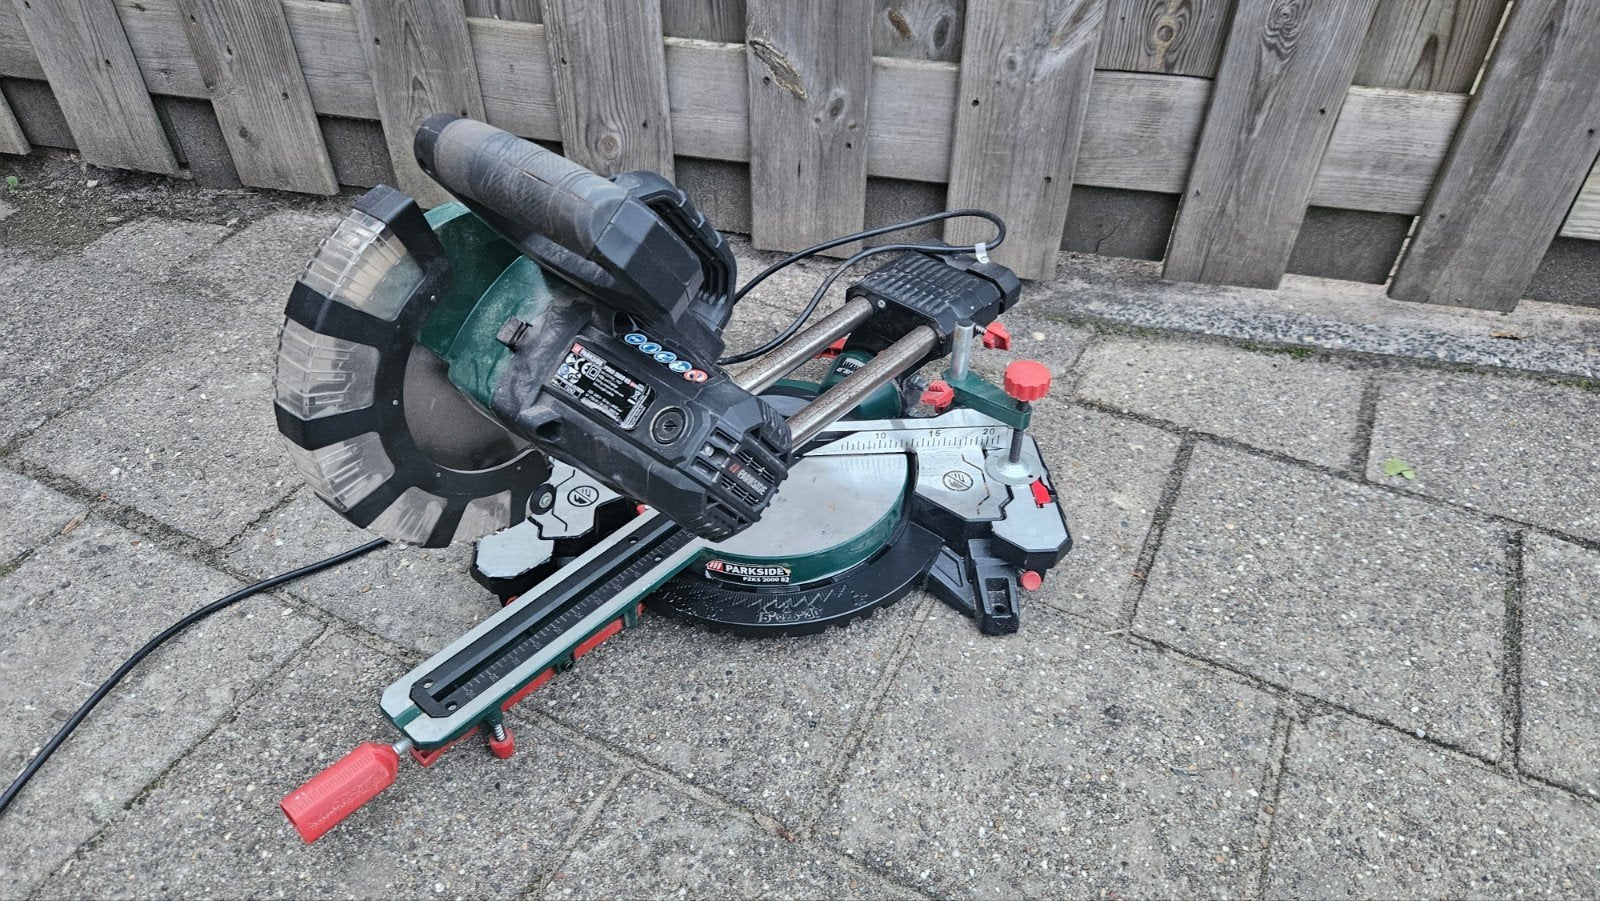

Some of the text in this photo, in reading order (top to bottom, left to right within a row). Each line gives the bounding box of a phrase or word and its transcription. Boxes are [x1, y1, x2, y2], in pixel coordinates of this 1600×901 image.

[875, 428, 996, 440] 10 15 20
[737, 469, 768, 496] PARKSIDE
[725, 564, 785, 576] PARKSIDE
